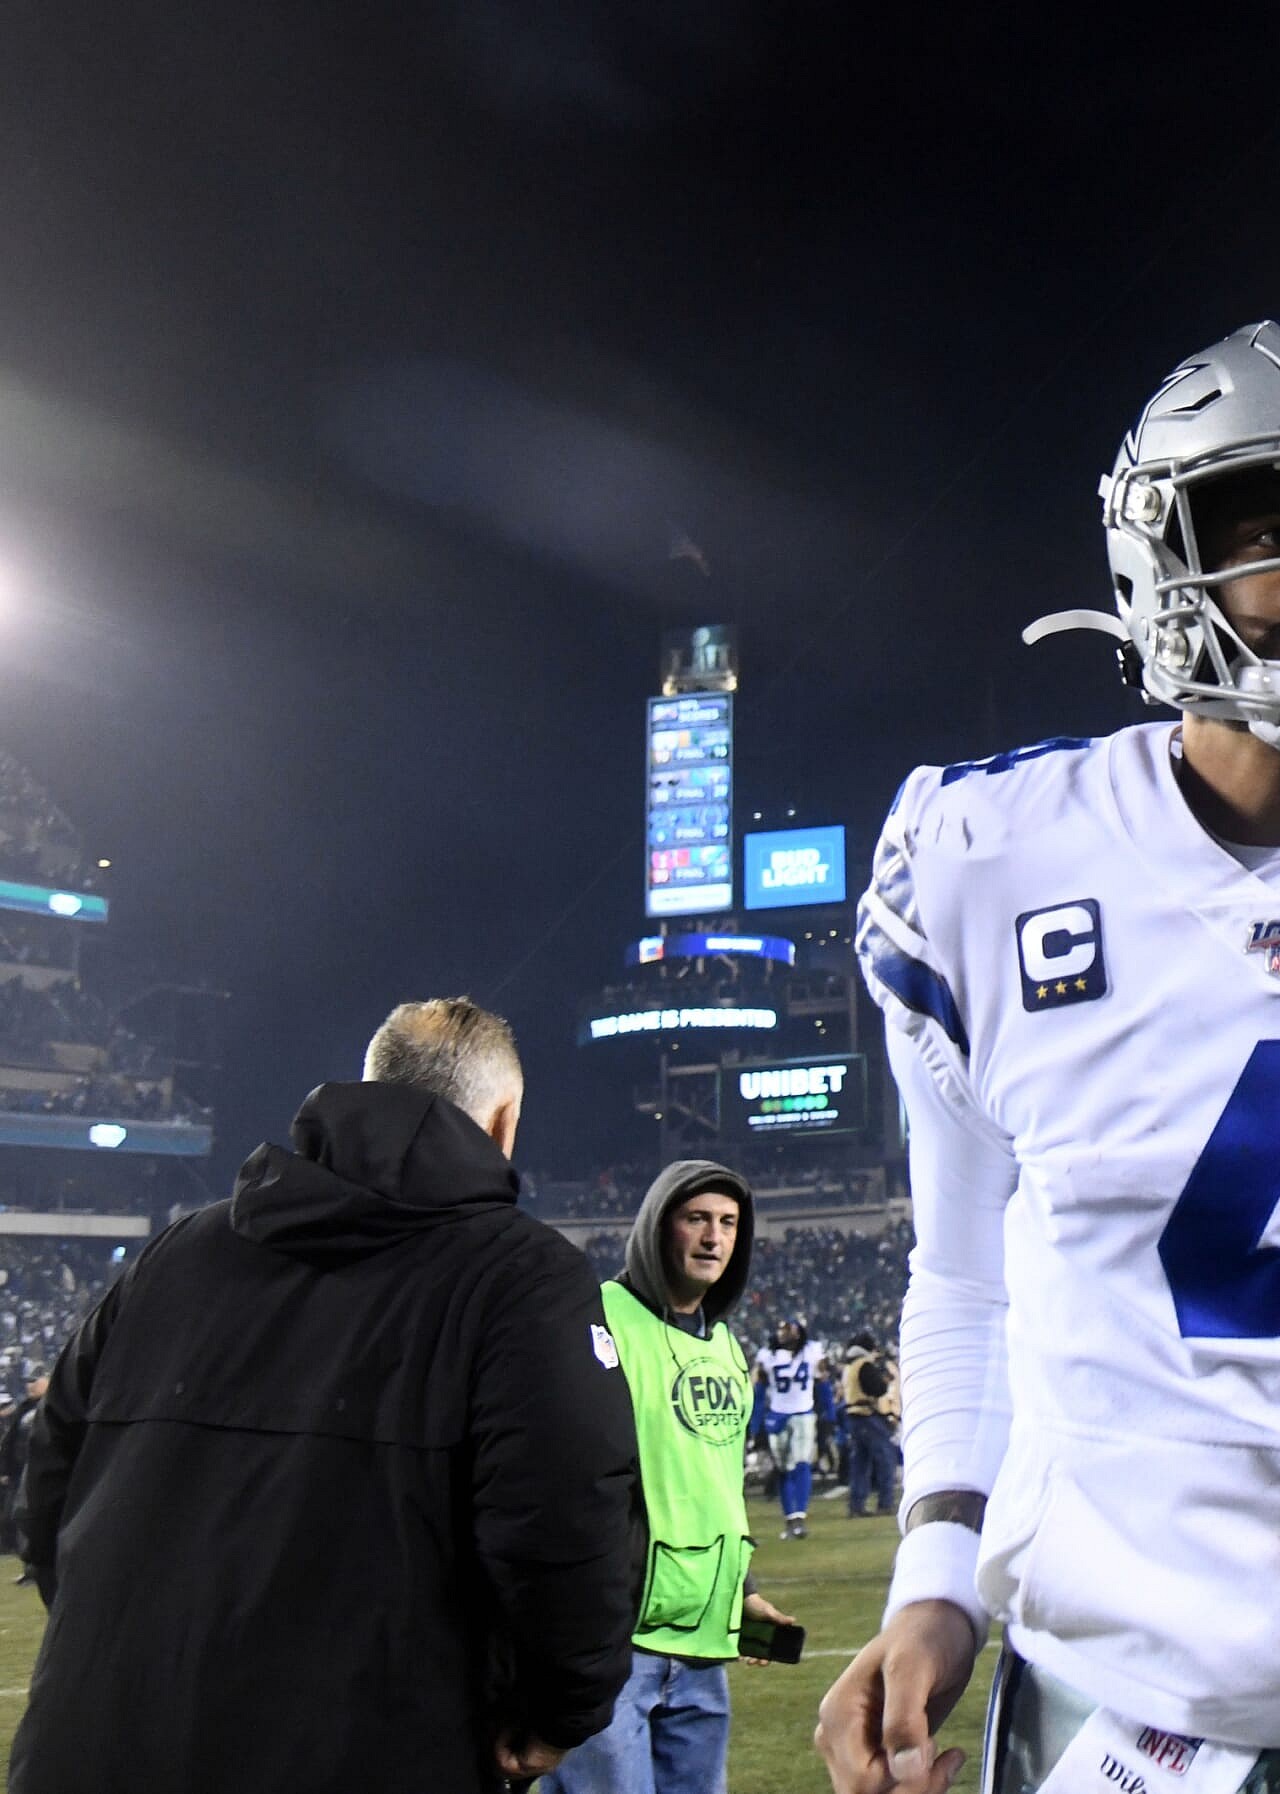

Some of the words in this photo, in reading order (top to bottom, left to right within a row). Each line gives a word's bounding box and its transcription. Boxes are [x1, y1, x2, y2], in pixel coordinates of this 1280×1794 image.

[771, 848, 820, 868] BUD
[762, 864, 829, 888] LIGHT
[1021, 906, 1096, 982] C
[739, 1065, 847, 1100] UNIBET
[688, 1376, 737, 1412] FOX
[773, 1362, 809, 1393] 54
[1142, 1728, 1189, 1773] NFL
